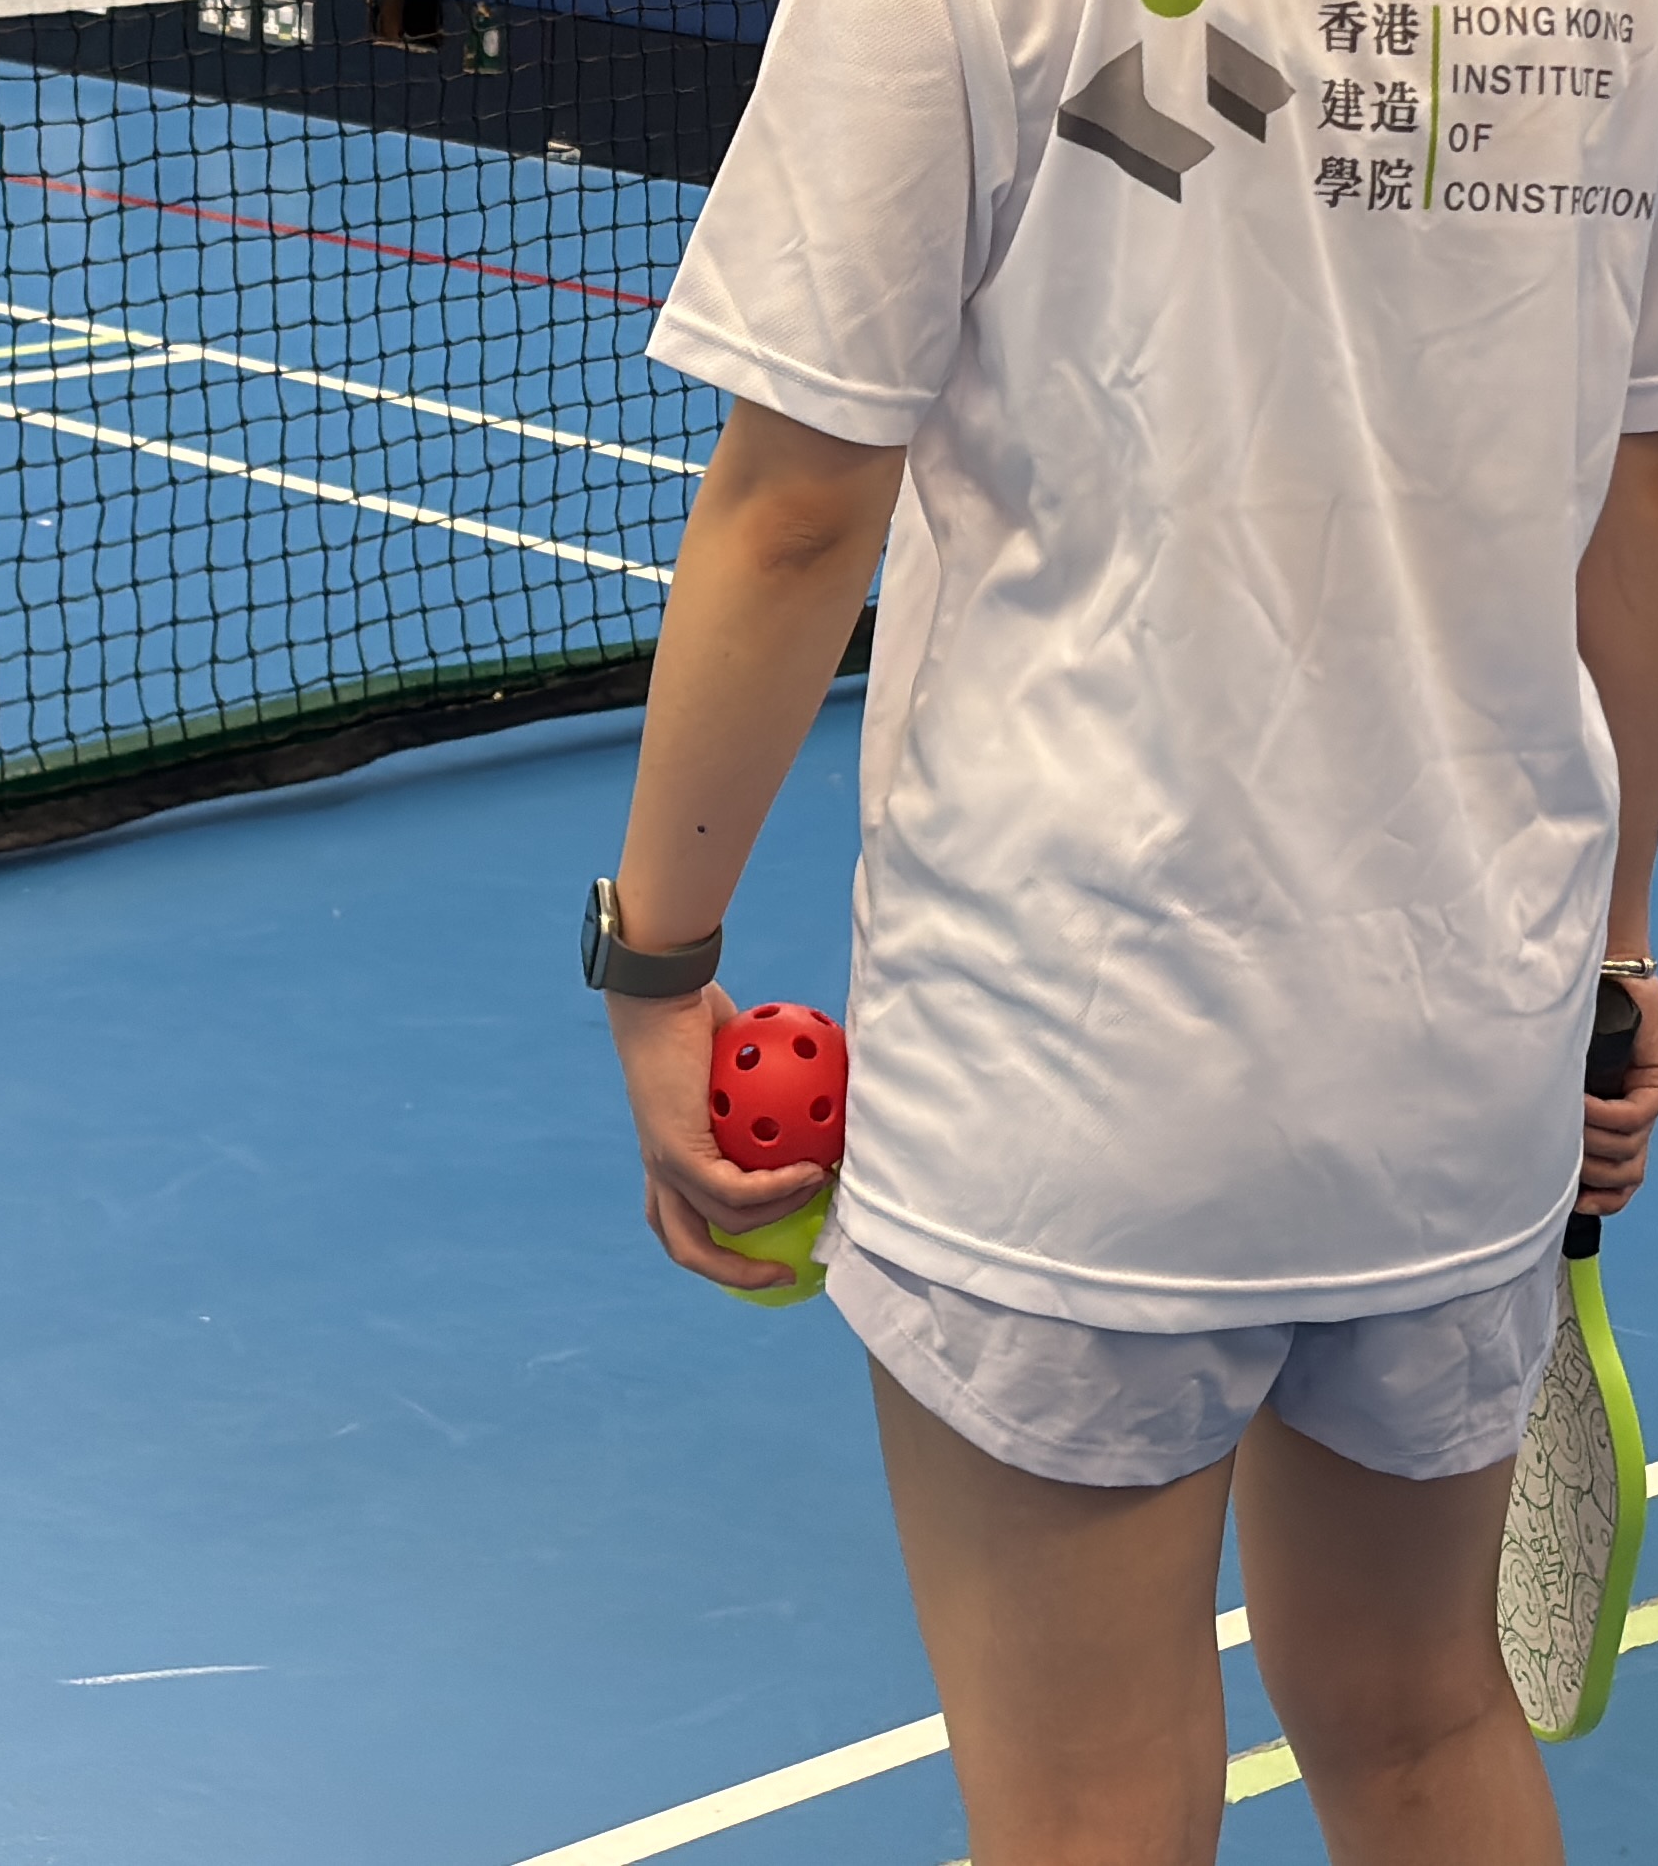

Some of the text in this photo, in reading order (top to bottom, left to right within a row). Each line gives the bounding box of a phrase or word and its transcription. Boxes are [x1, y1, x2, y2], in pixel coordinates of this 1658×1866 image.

[1317, 0, 1421, 56] 香港
[1453, 6, 1634, 44] HONG KONG
[1316, 78, 1421, 133] 建造
[1448, 122, 1493, 152] OF
[1313, 155, 1414, 211] 學院
